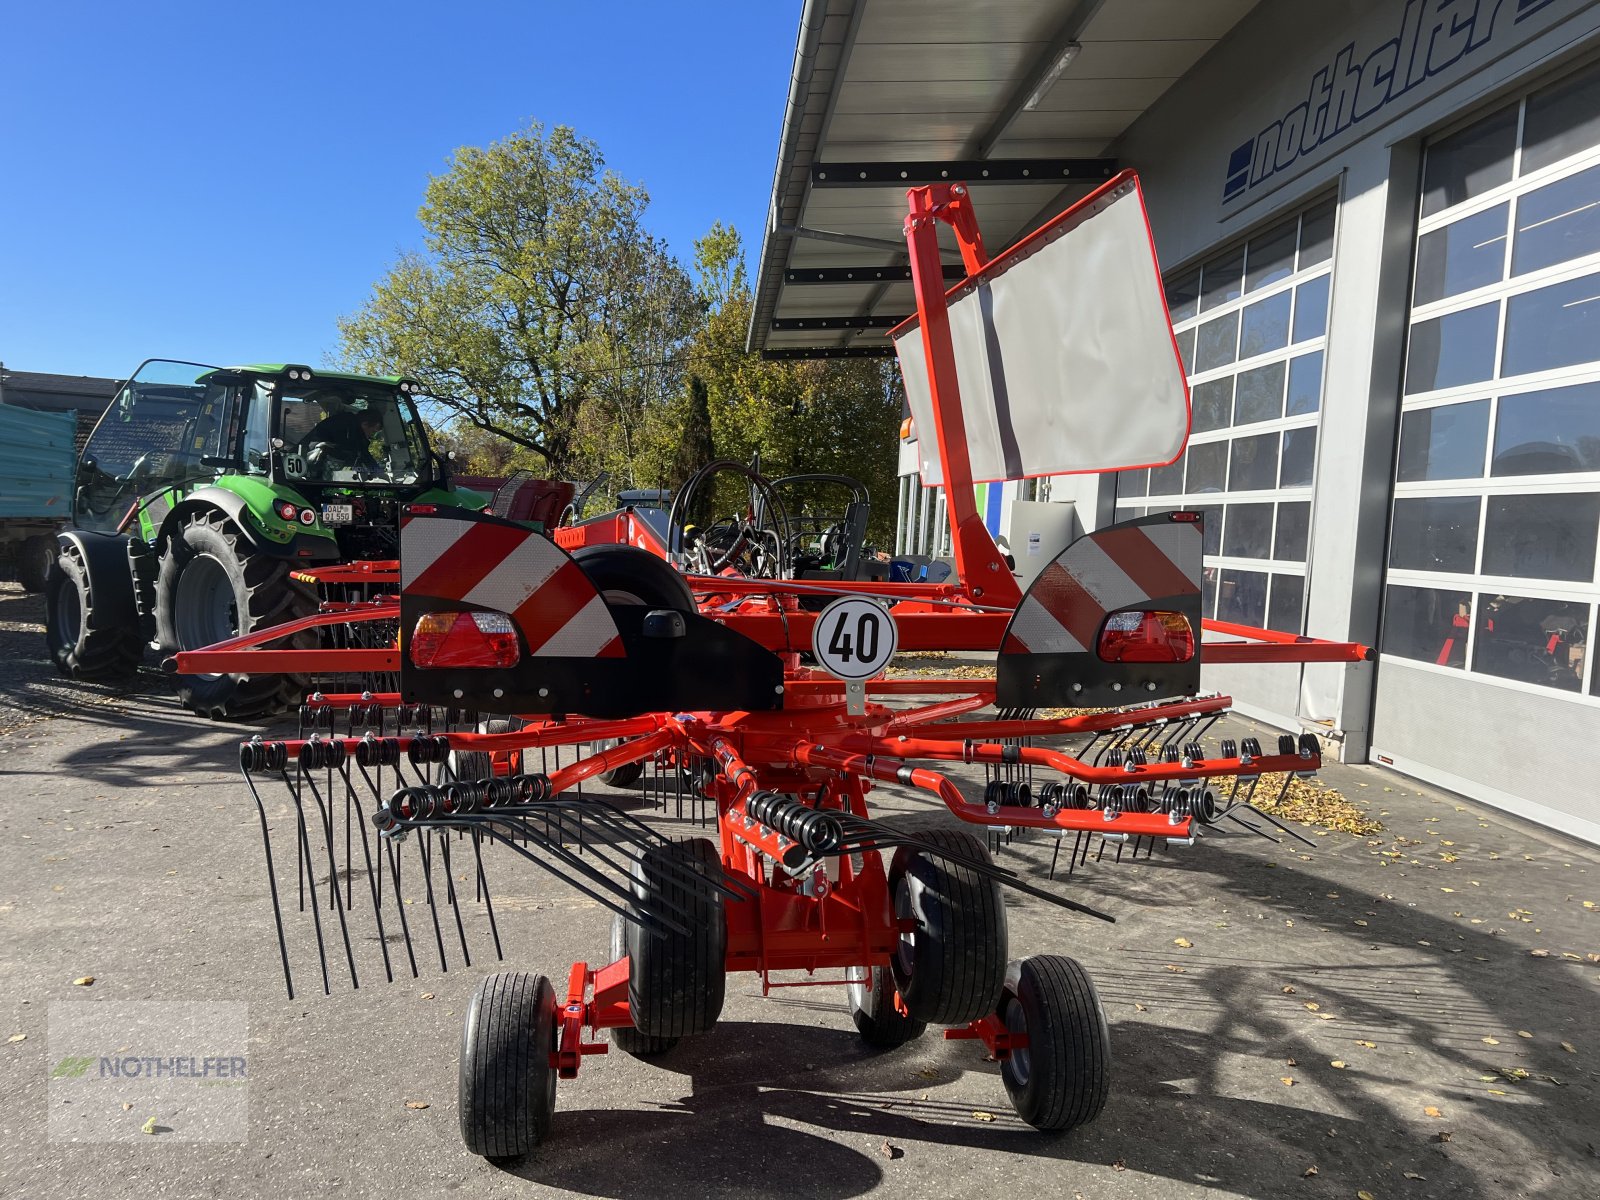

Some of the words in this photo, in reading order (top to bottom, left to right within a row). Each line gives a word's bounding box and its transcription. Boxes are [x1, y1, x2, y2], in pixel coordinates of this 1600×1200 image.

[288, 458, 302, 473] 50
[336, 512, 350, 521] 550
[828, 611, 880, 664] 40
